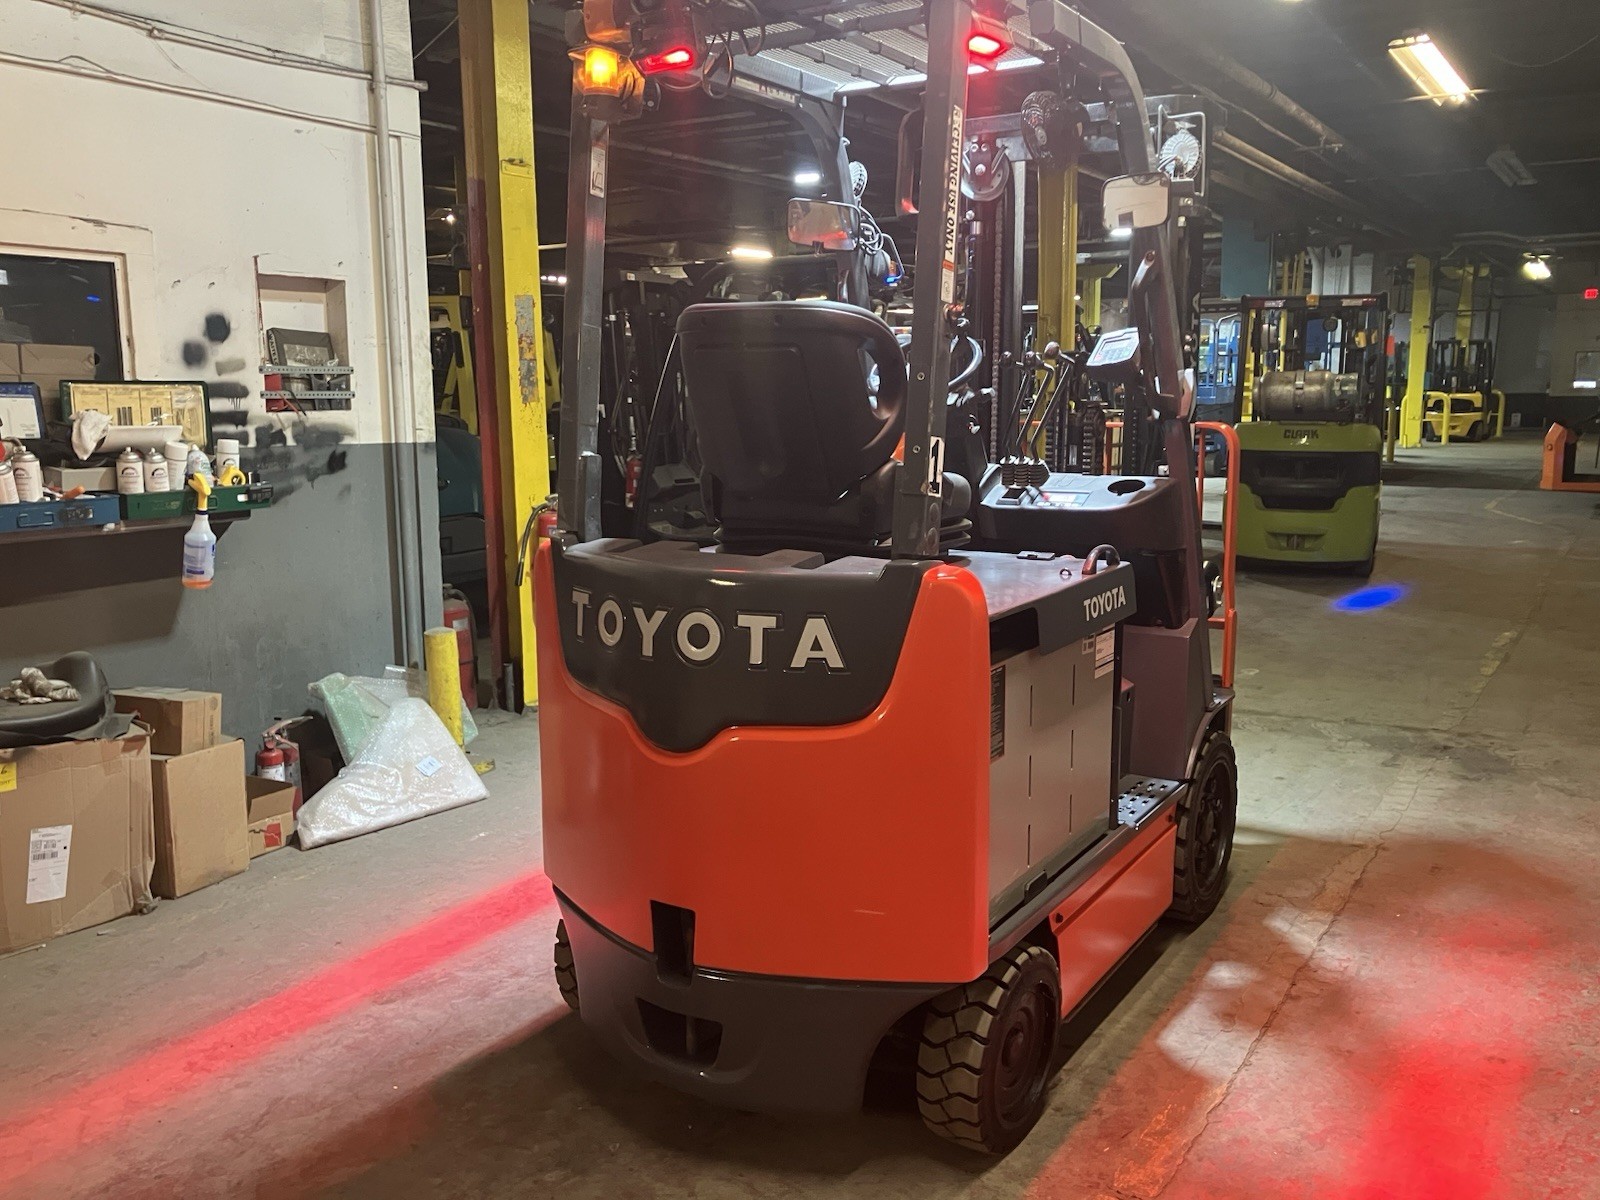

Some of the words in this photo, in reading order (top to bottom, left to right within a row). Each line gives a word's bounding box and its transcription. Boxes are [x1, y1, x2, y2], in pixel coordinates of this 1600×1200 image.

[948, 189, 957, 215] USE
[945, 217, 955, 256] ONLY
[1284, 430, 1319, 439] CLARK
[1083, 586, 1126, 621] TOYOTA
[572, 589, 846, 669] TOYOTA
